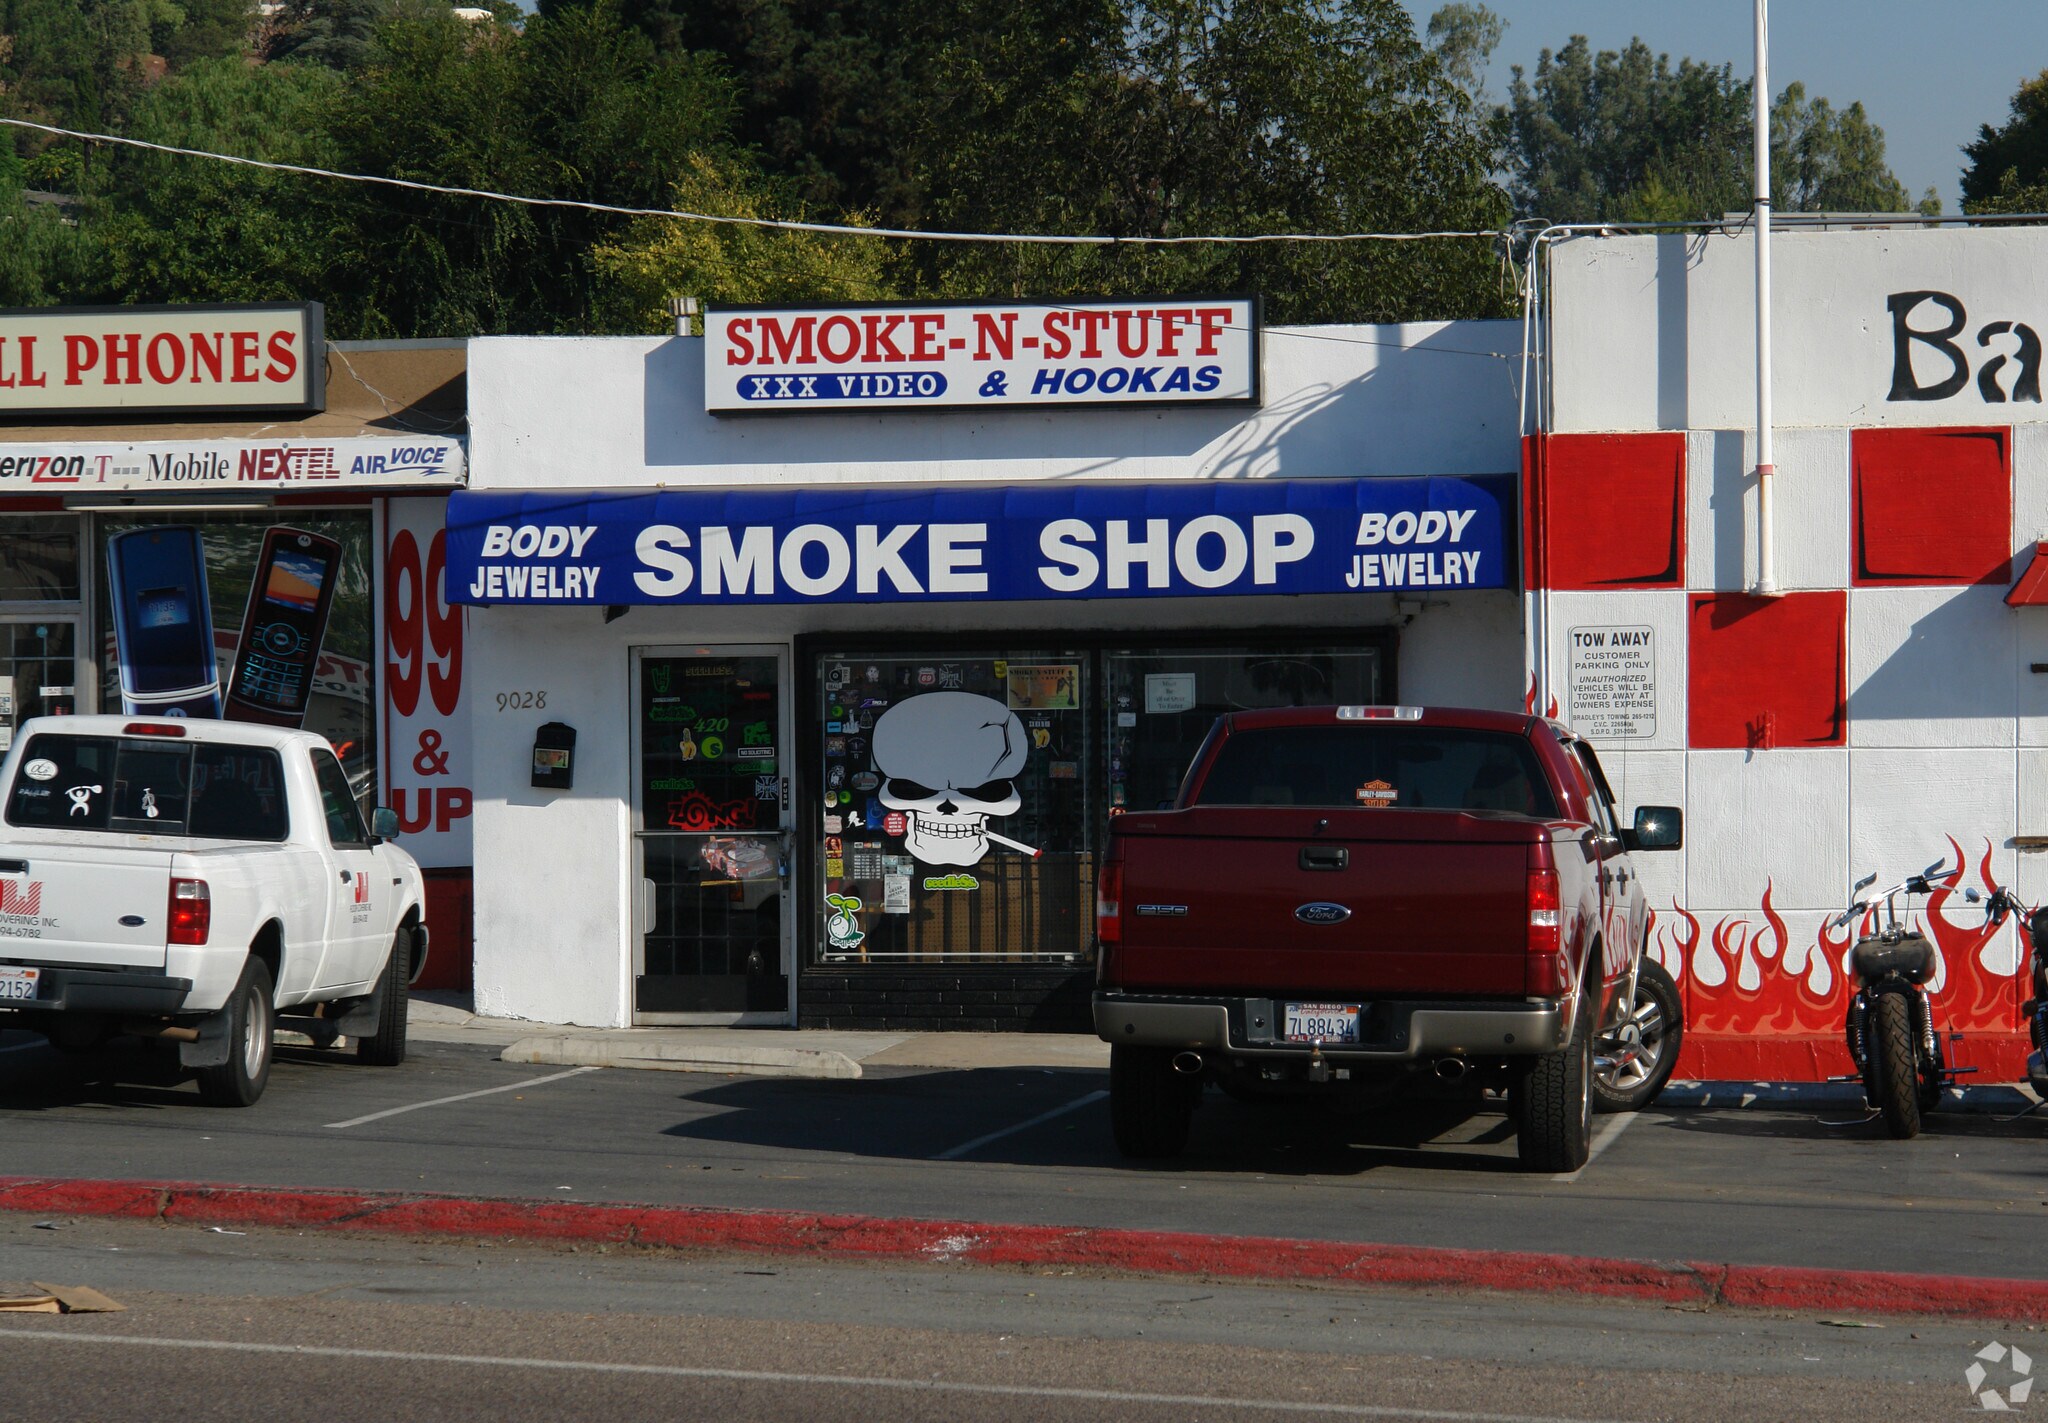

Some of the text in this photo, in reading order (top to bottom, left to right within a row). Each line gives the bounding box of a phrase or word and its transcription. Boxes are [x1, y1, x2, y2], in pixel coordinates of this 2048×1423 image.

[726, 308, 1232, 365] SMOKE-N-STUFF
[64, 330, 297, 385] PHONES
[750, 365, 1222, 398] XXX VIDEO & HOOKAS
[0, 455, 84, 483] erizon
[238, 447, 340, 481] NEXTEL
[350, 446, 448, 475] AIR VOICE
[481, 525, 597, 558] BODY
[1356, 510, 1477, 546] BODY
[633, 513, 1314, 597] SMOKE SHOP
[1345, 551, 1480, 588] JEWELRY
[470, 566, 600, 598] JEWELRY
[388, 529, 463, 717] 99
[1574, 632, 1650, 647] TOW AWAY
[1584, 652, 1640, 660] CUSTOMER
[1624, 661, 1650, 669] ONLY
[1573, 684, 1614, 692] VEHICLES
[1642, 683, 1654, 691] BE
[1579, 675, 1646, 683] UNAUTHORIZED
[496, 691, 547, 712] 9028
[1573, 700, 1654, 709] OWNERS EXPENSE
[694, 718, 729, 732] 420
[413, 729, 449, 776] &
[392, 787, 473, 834] UP
[1307, 906, 1338, 920] Ford
[1288, 1018, 1354, 1037] 7L88434
